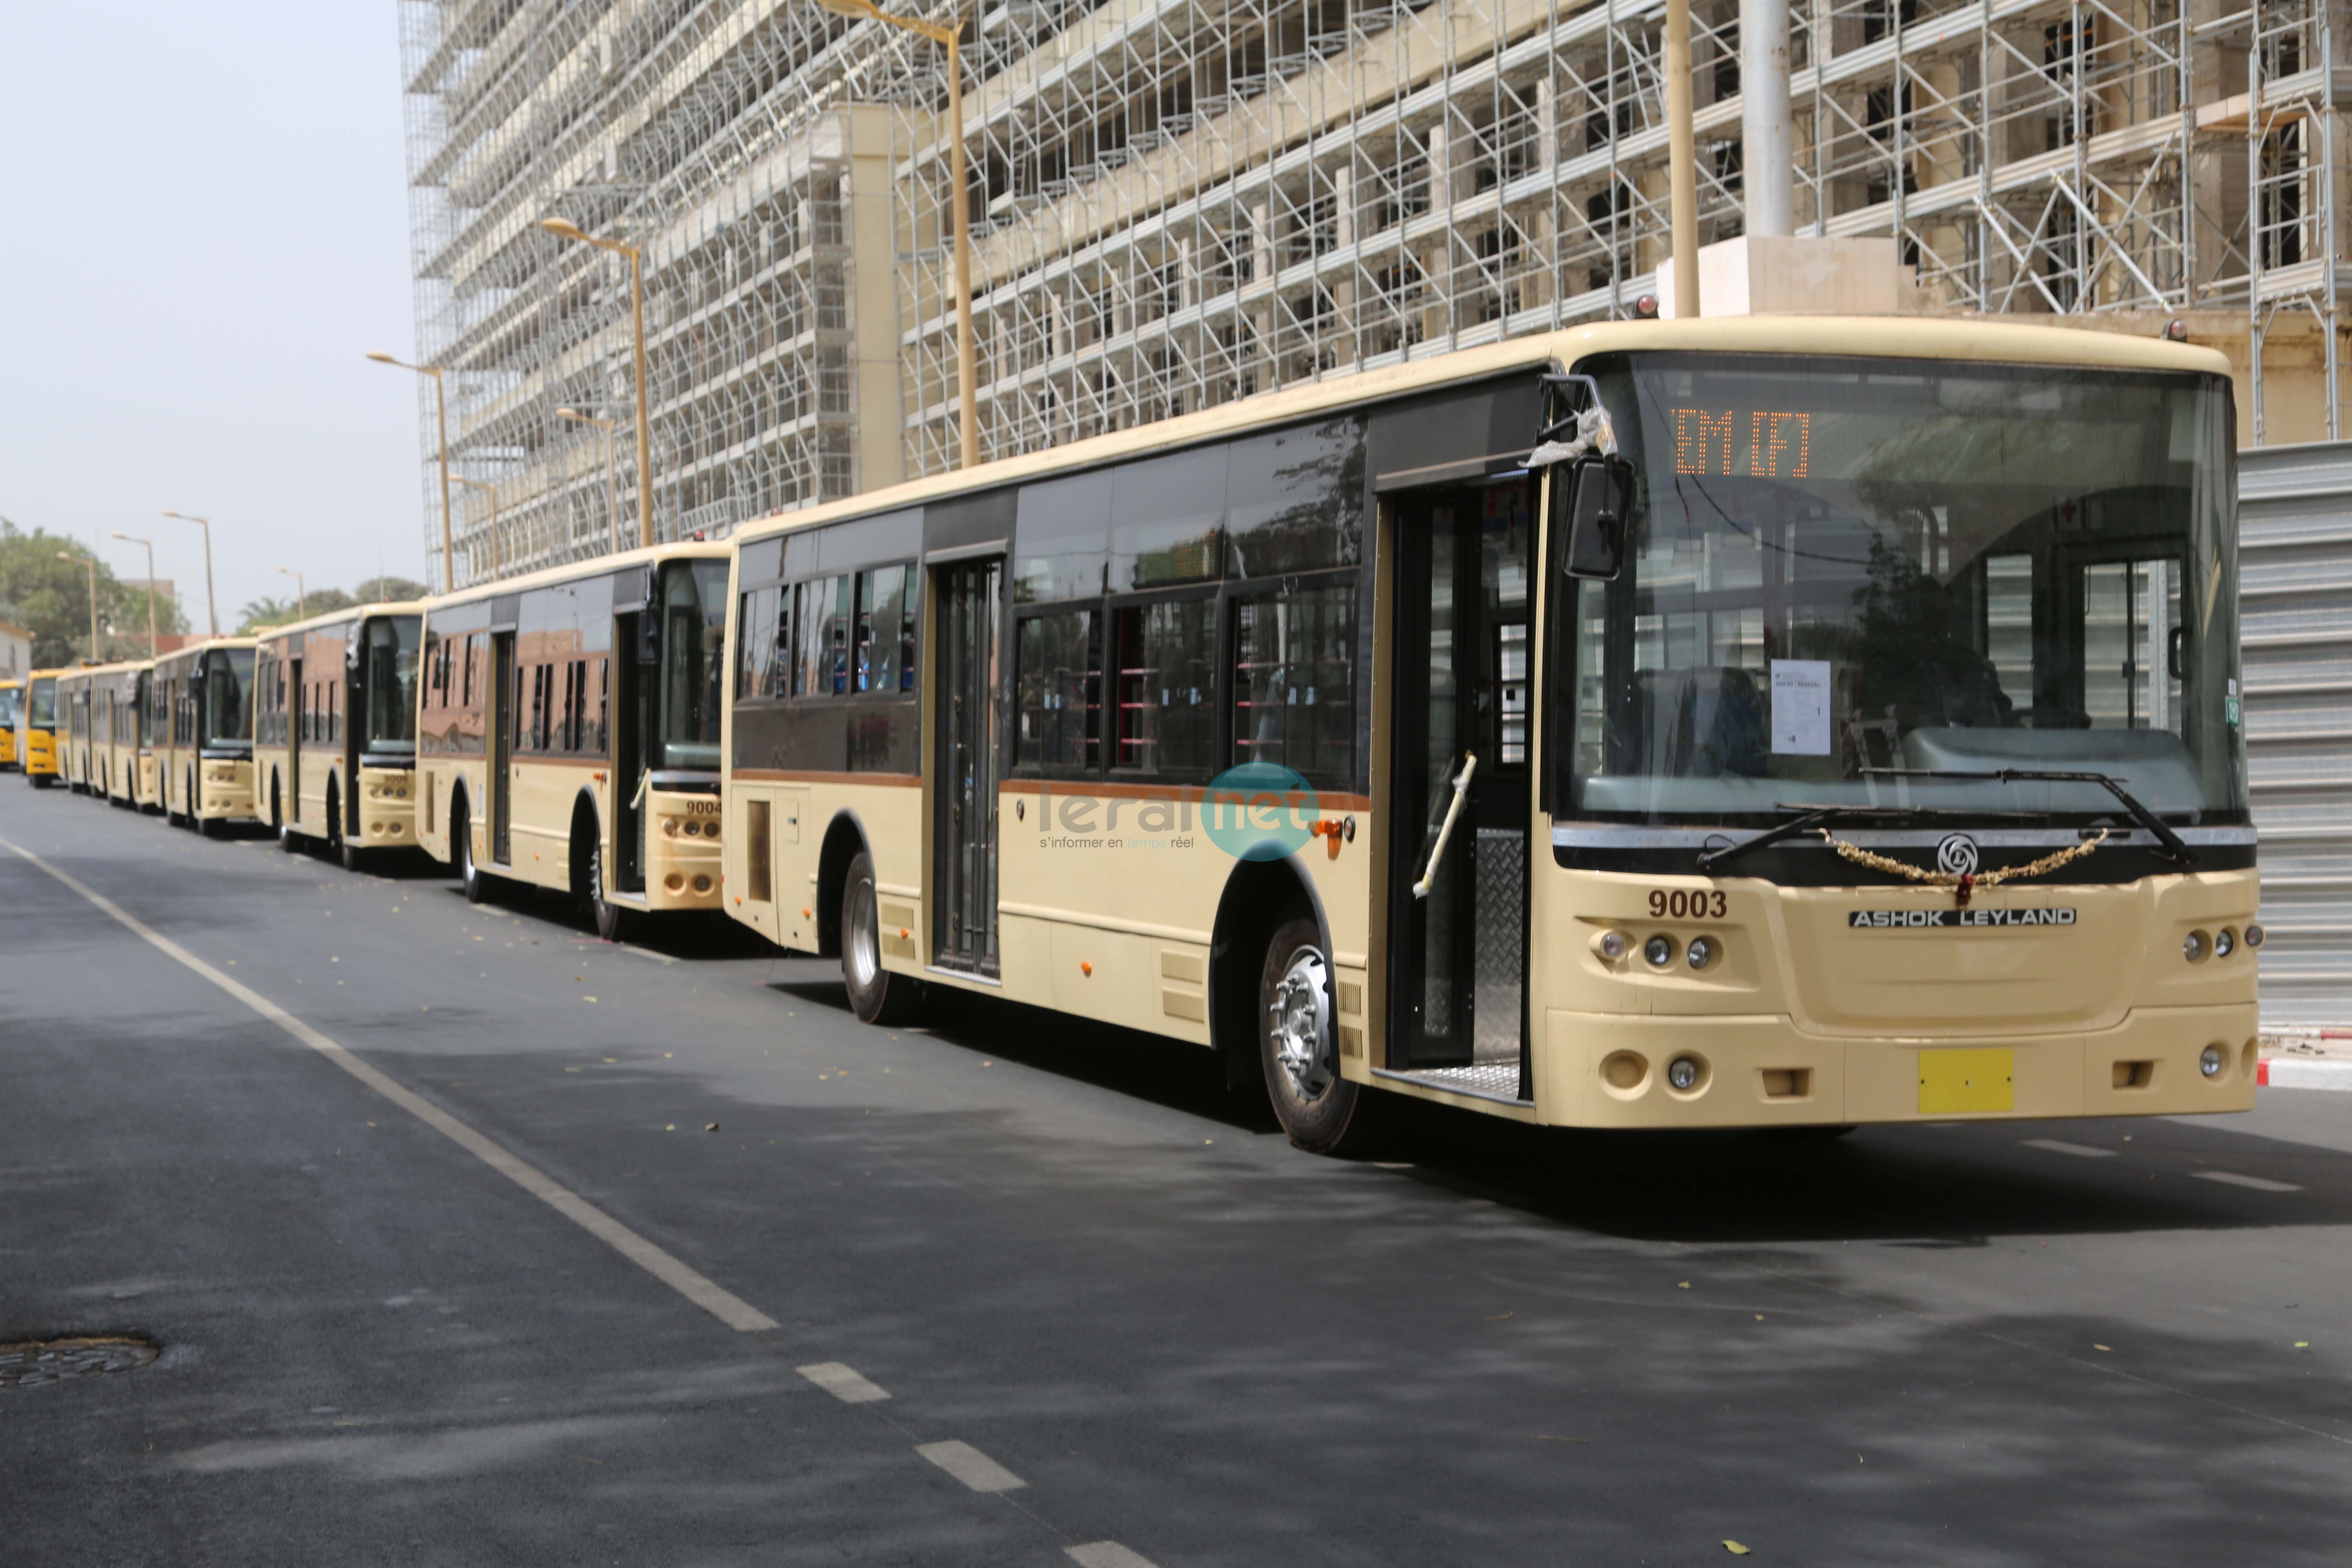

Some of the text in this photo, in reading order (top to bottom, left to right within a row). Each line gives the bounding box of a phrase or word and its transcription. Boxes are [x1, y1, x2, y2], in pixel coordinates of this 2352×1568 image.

[1670, 409, 1810, 477] EM [F]
[1649, 890, 1727, 918] 9003
[1853, 909, 2075, 927] ASHOK LEYLAND
